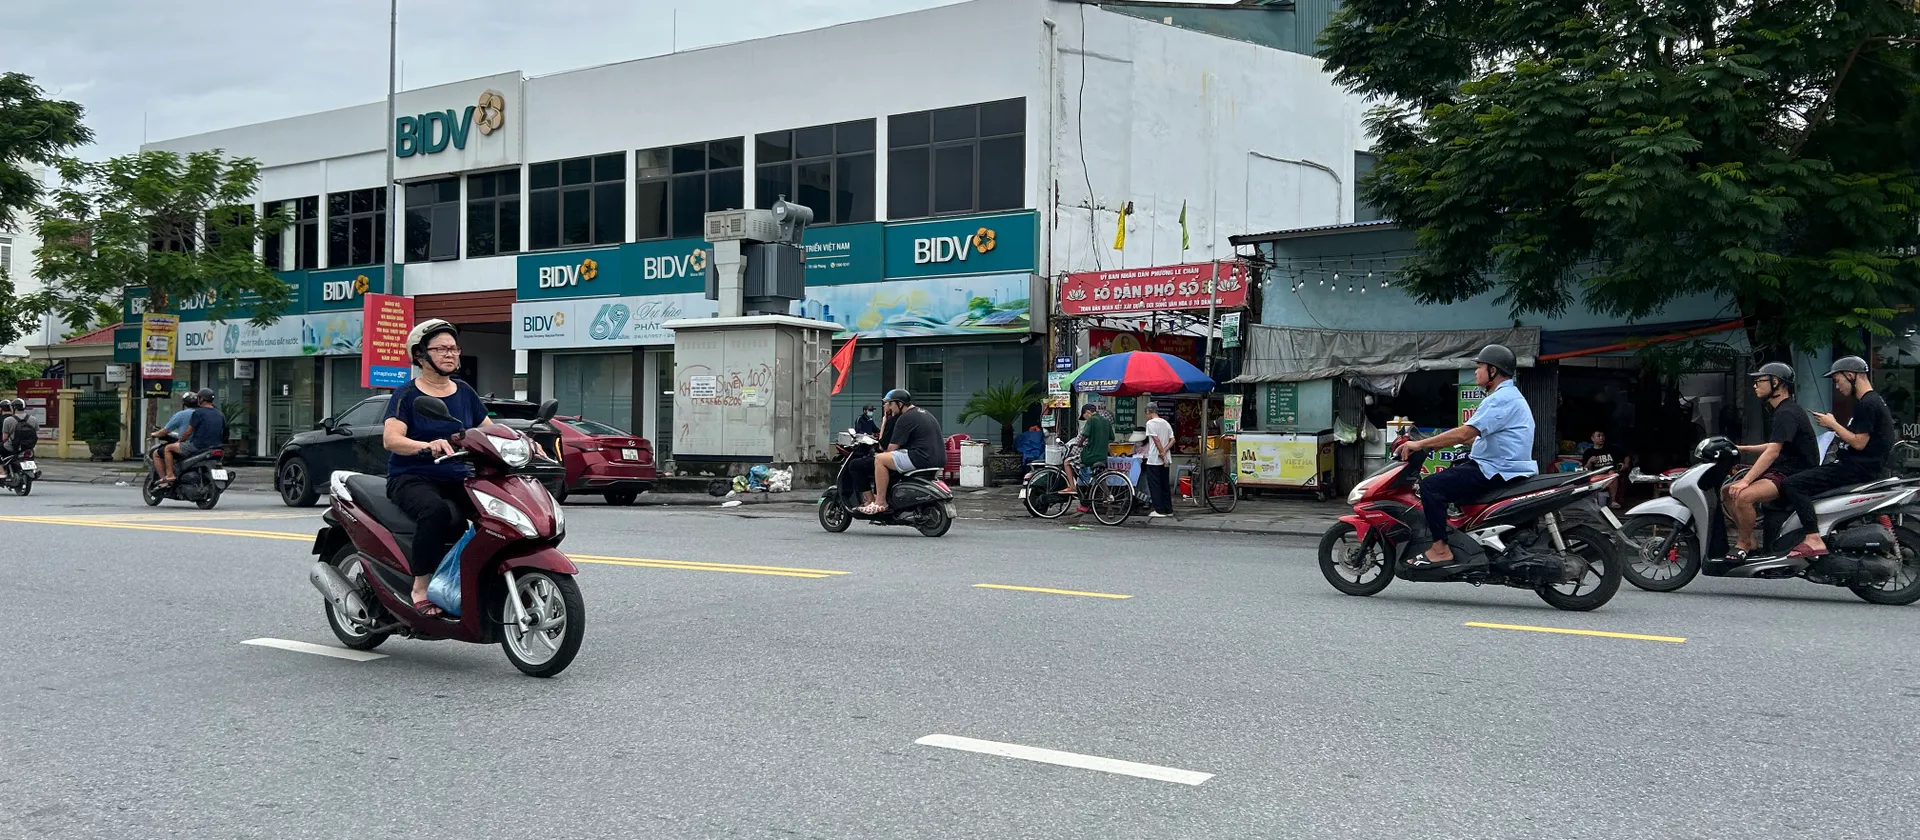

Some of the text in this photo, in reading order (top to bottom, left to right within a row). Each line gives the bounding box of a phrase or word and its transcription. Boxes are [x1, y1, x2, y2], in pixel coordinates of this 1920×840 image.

[396, 105, 477, 158] BIDV
[823, 242, 835, 252] VIỆT
[836, 242, 850, 250] NAM
[914, 234, 974, 264] BIDV
[539, 264, 581, 289] BIDV
[644, 255, 691, 280] BIDV
[323, 280, 356, 301] BIDV
[1113, 283, 1142, 300] DÂN
[1144, 276, 1175, 298] PHỐ
[1179, 275, 1200, 296] SỐ
[523, 315, 553, 332] BIDV
[589, 304, 631, 341] 69
[634, 321, 660, 331] PHÁT
[186, 331, 207, 346] BIDV
